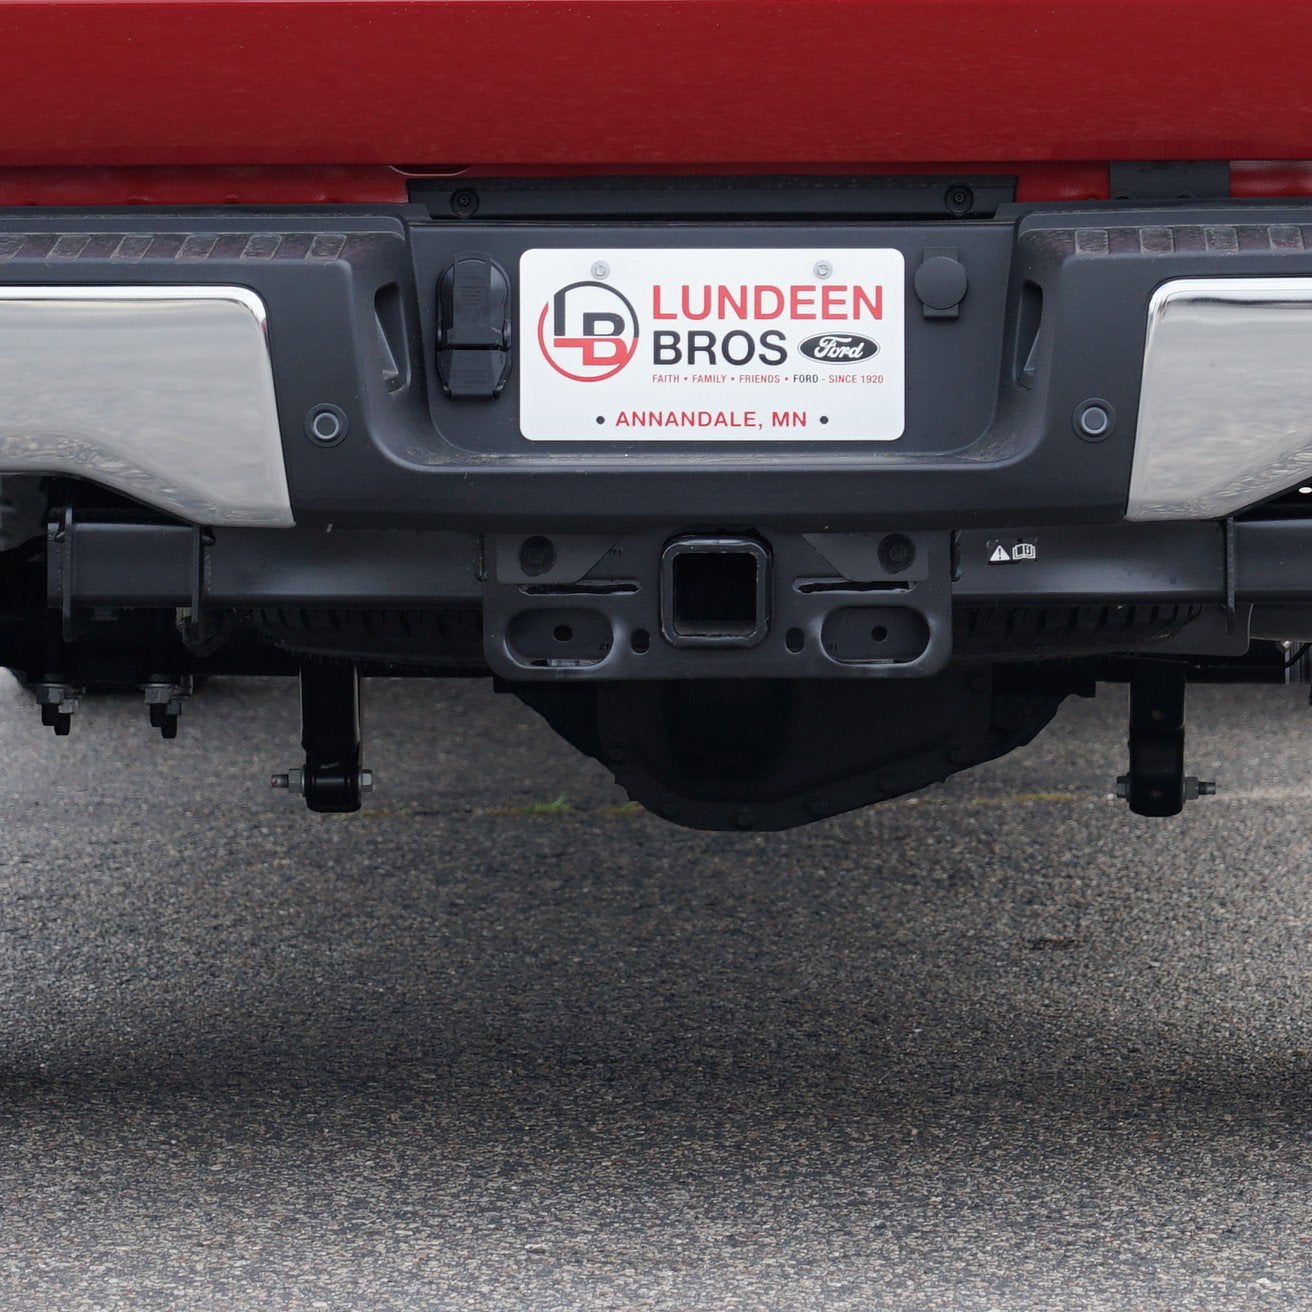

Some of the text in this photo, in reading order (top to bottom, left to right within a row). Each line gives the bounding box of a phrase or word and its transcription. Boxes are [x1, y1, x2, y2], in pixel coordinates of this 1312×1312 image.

[653, 285, 882, 320] LUNDEEN
[653, 330, 787, 366] BROS
[652, 374, 884, 383] FAITH FAMILY FRIENDS FORD SINCE 1920
[615, 411, 807, 430] ANNANDALE, MN
